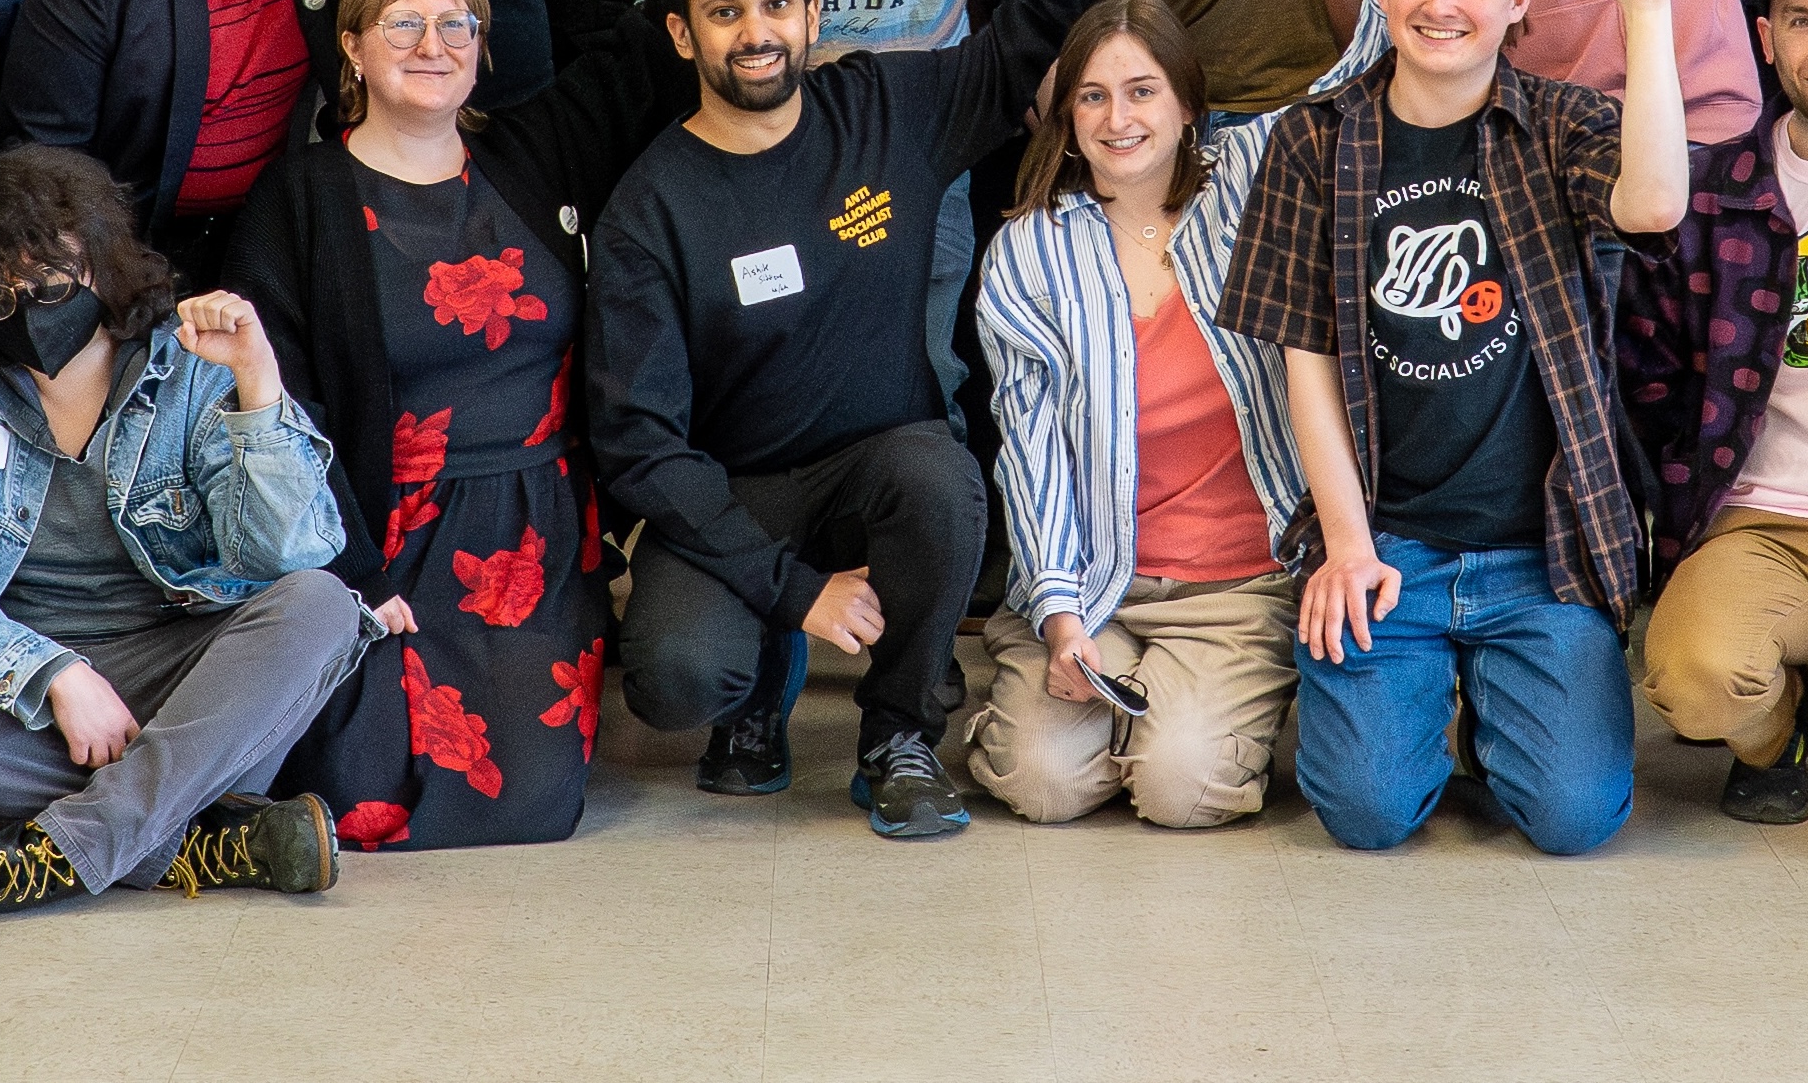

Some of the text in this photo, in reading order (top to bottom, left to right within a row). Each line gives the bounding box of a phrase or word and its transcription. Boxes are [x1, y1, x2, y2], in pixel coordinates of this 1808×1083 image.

[829, 189, 892, 231] BILLIONAIRE
[844, 185, 871, 211] ANTI
[838, 206, 893, 241] SOCIALIST
[857, 227, 888, 248] CLUB
[1389, 336, 1508, 381] SOCIALISTS
